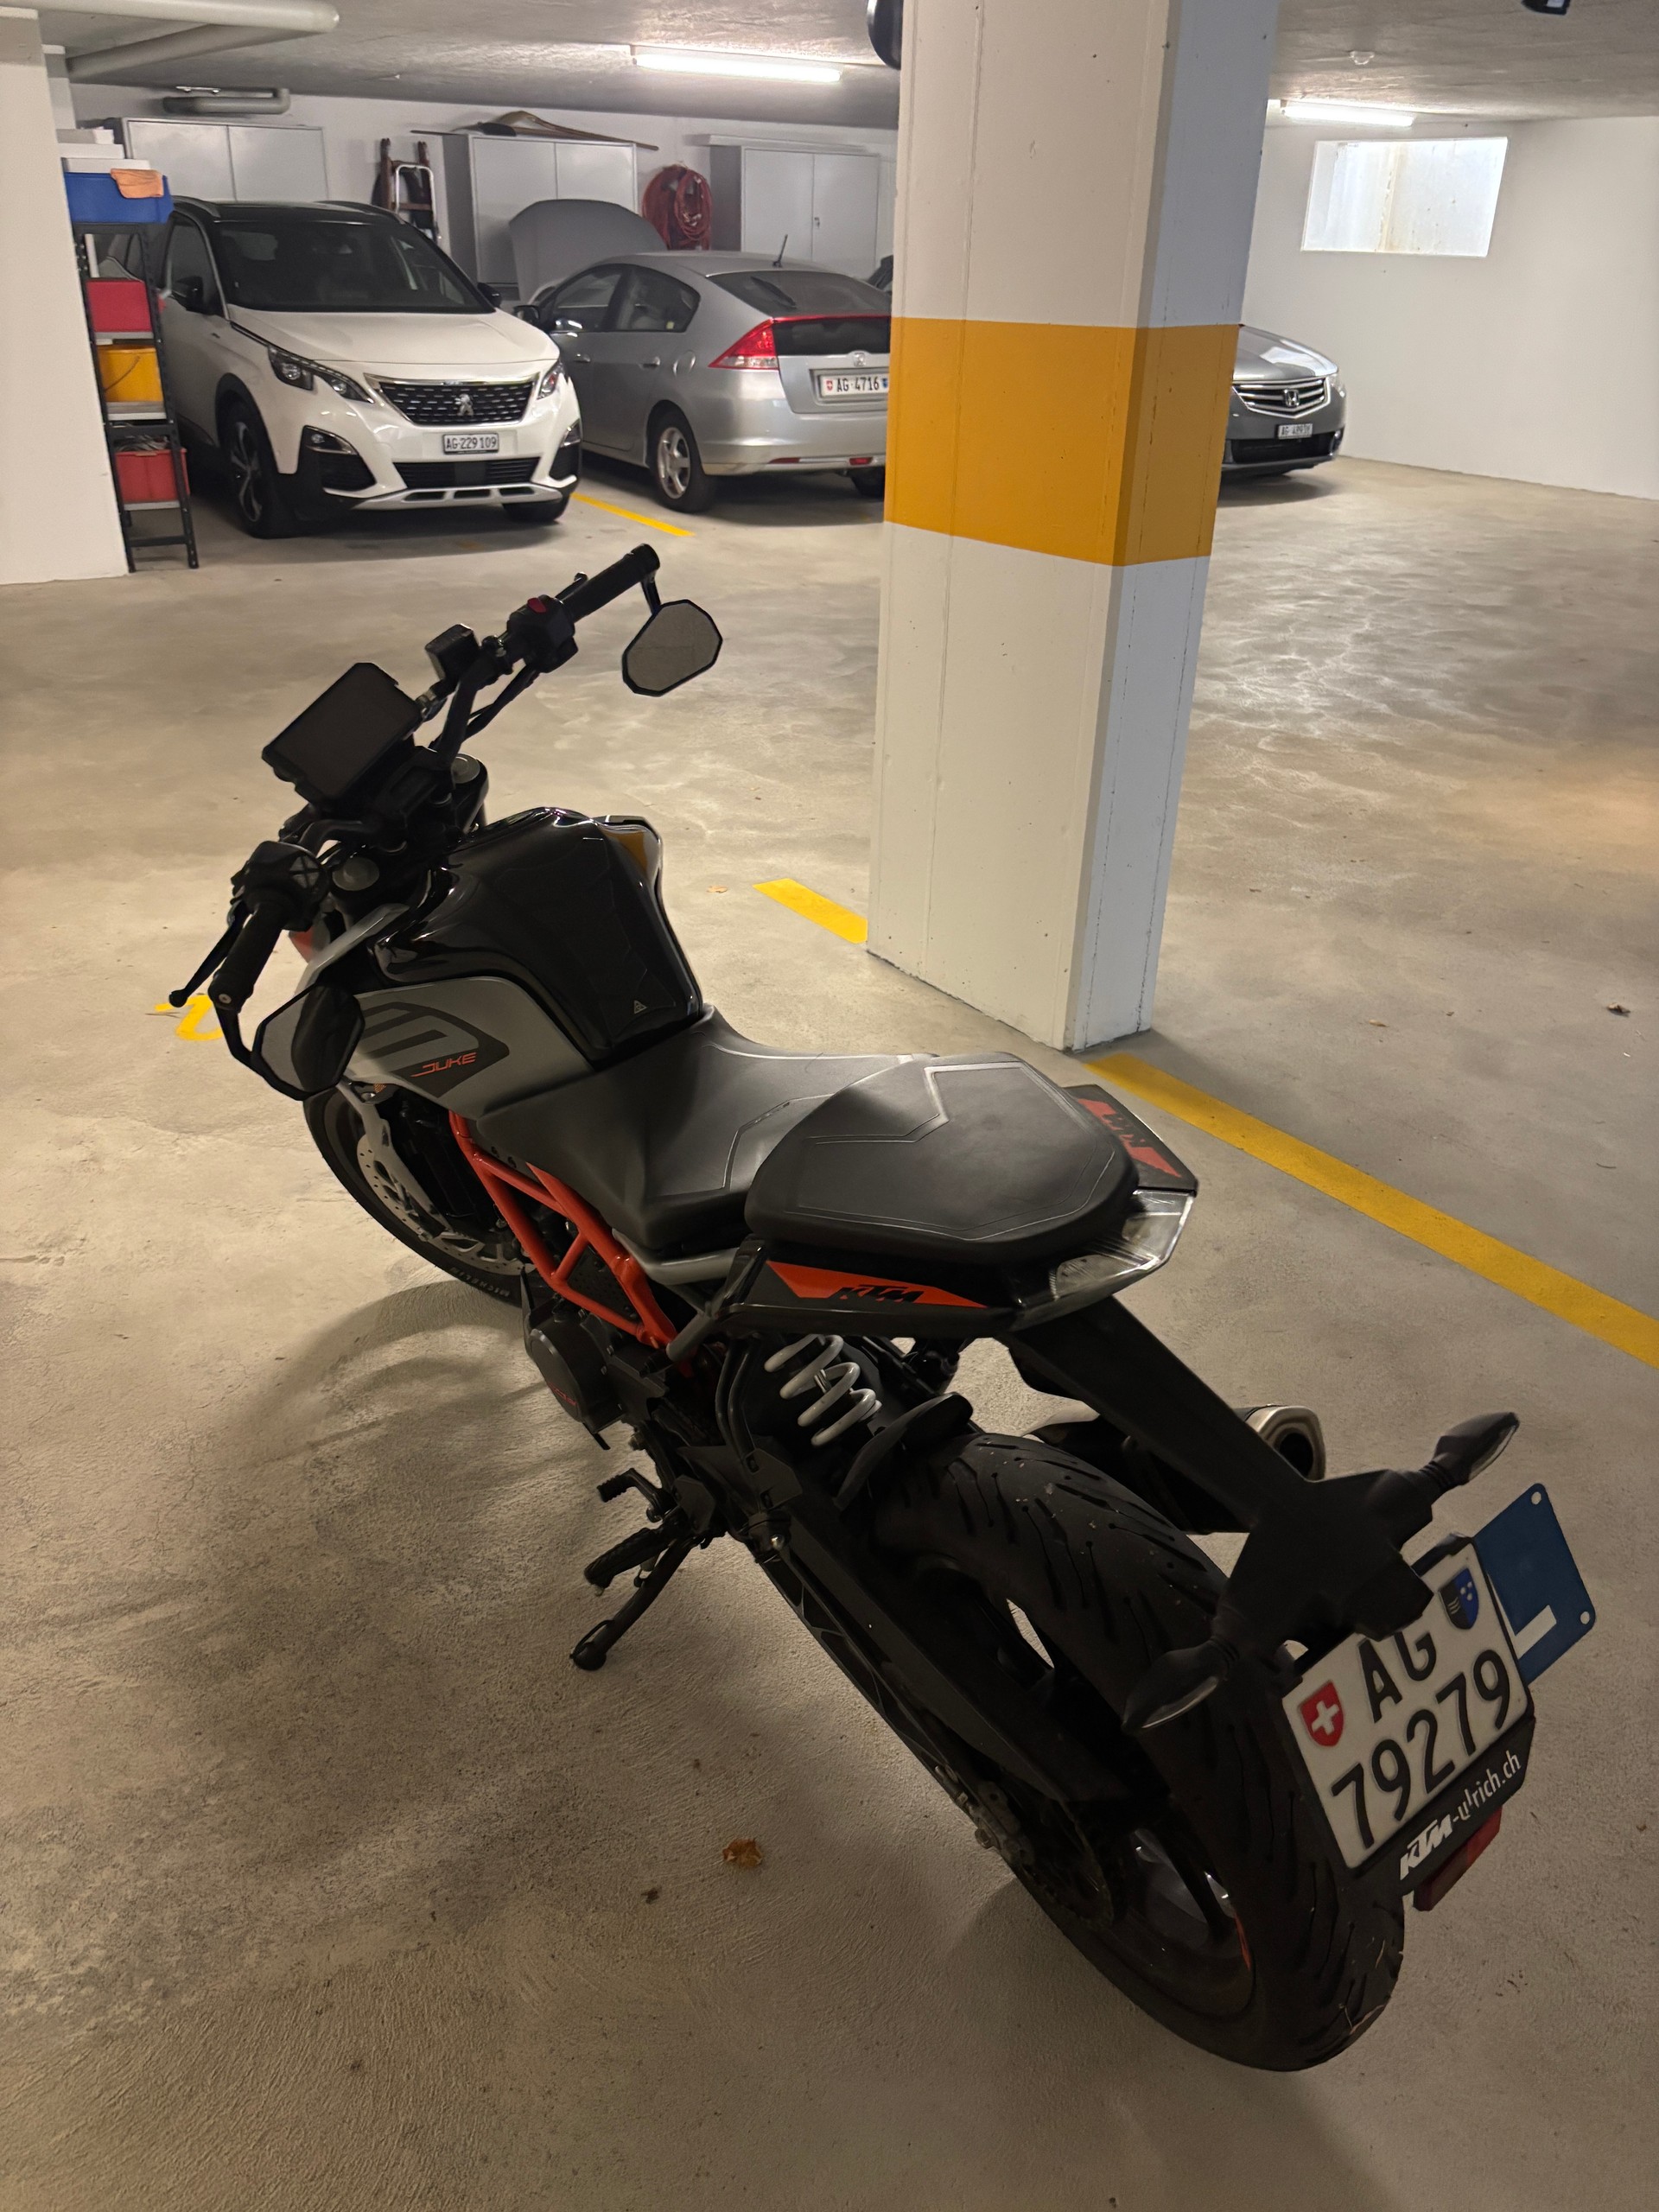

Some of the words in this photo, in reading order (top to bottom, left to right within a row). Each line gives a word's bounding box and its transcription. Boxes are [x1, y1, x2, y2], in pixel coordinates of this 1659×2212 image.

[855, 376, 880, 391] 4716
[410, 1052, 478, 1077] DUKE
[827, 1284, 925, 1304] KTM
[1357, 1630, 1438, 1725] AG
[1331, 1648, 1511, 1851] 79279
